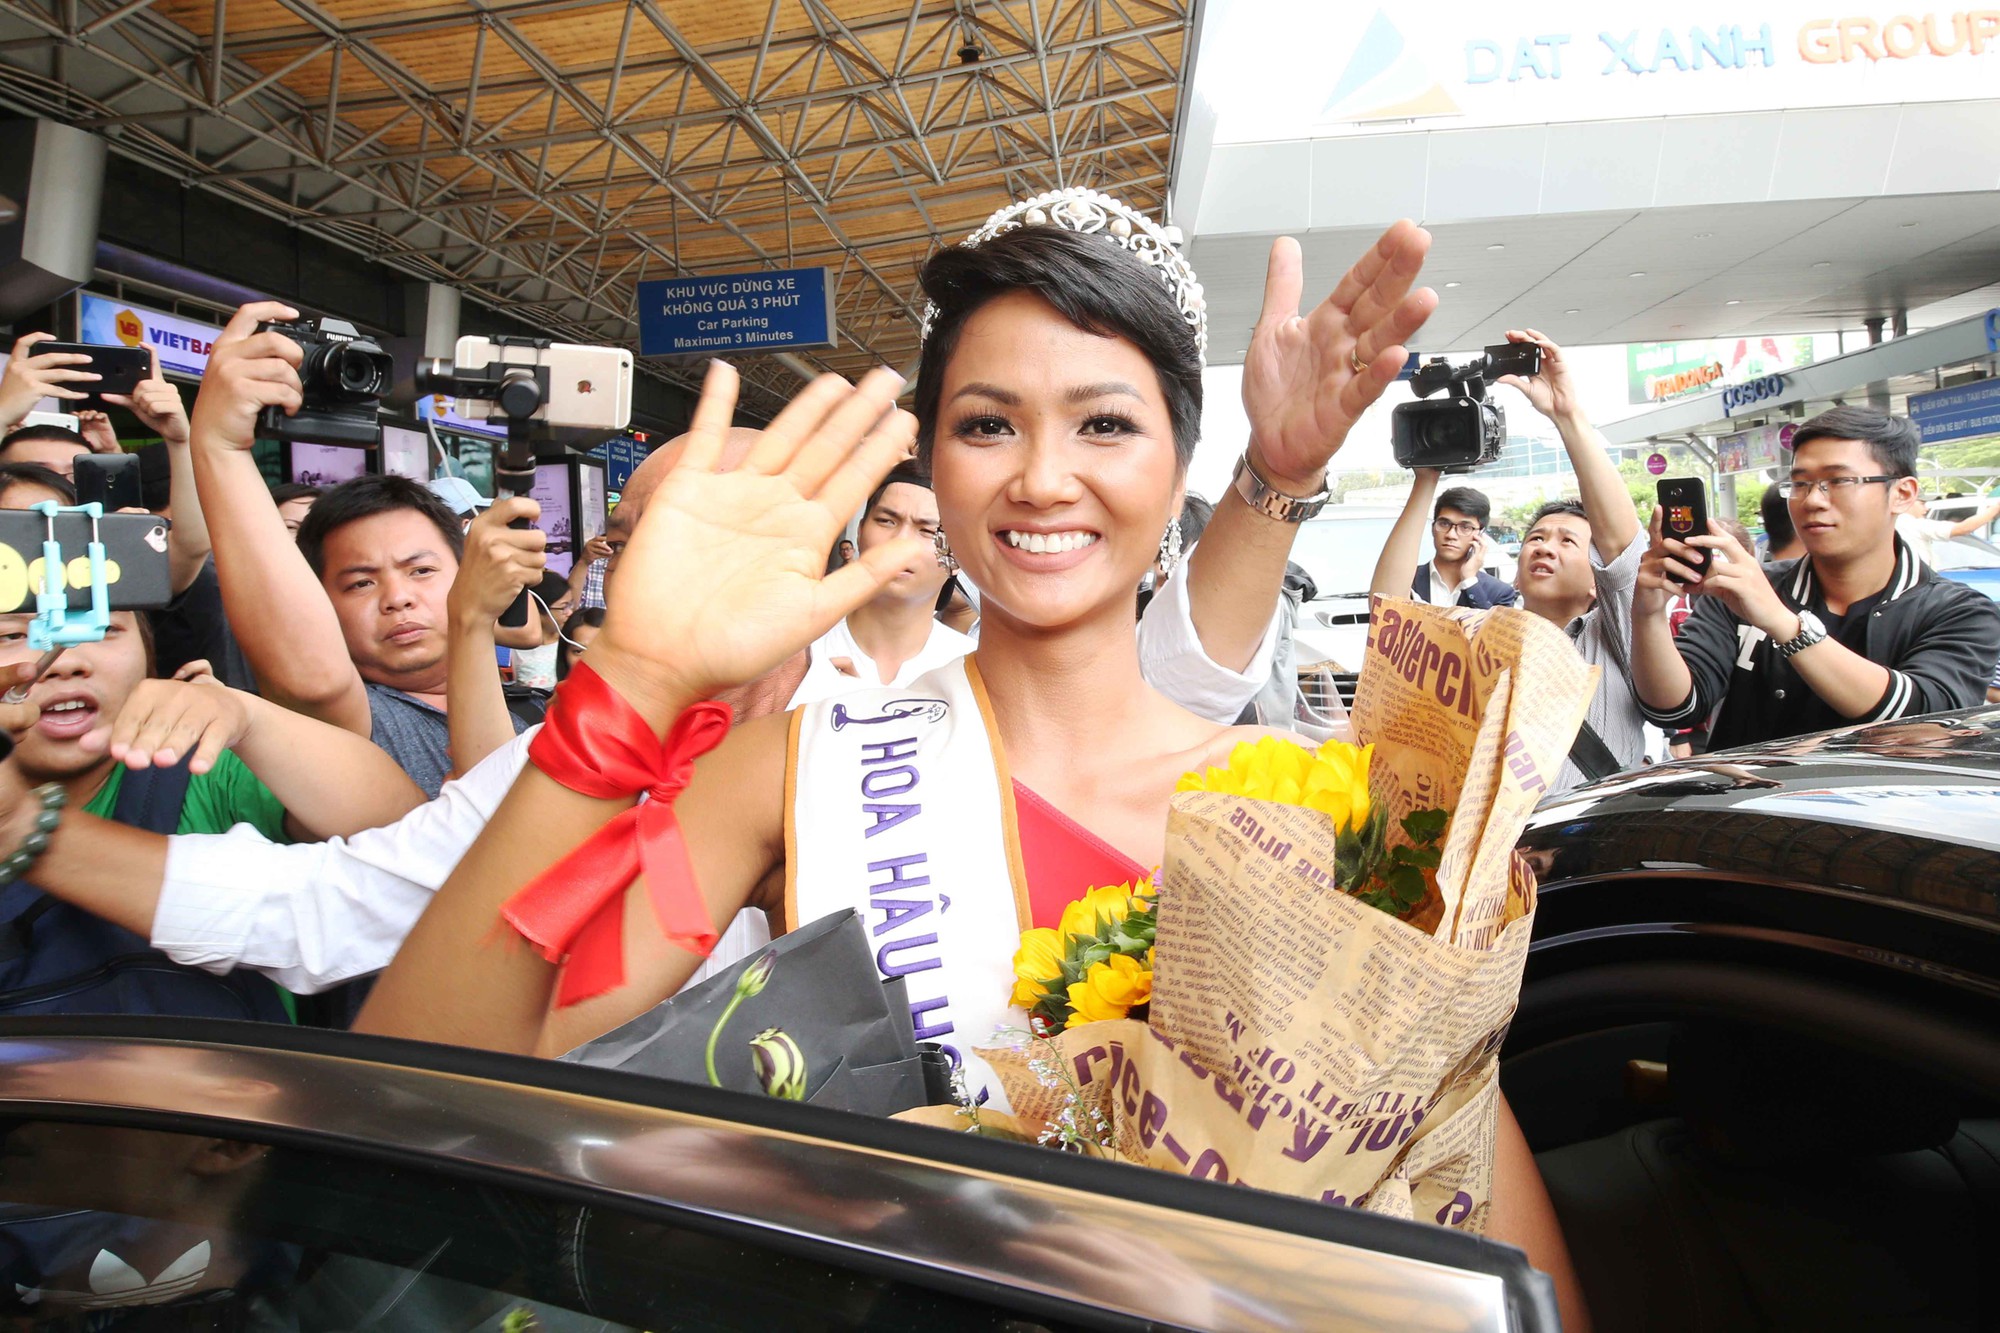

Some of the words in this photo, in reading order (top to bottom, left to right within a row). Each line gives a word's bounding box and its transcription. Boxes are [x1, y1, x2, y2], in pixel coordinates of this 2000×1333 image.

[1464, 34, 1571, 84] DAT
[1598, 23, 1775, 76] XANH
[1797, 10, 2000, 64] GROUP
[666, 287, 695, 299] KHU
[699, 282, 729, 298] VỰC
[732, 278, 773, 294] DỪNG
[777, 278, 795, 291] XE
[663, 300, 713, 316] KHÔNG
[717, 296, 747, 312] QUÁ
[751, 297, 759, 309] 3
[763, 293, 801, 308] PHÚT
[697, 320, 718, 331] Car
[722, 316, 769, 330] Parking
[674, 333, 732, 348] Maximum
[735, 333, 742, 344] 3
[746, 330, 794, 343] Minutes
[861, 736, 922, 839] HOA
[1223, 805, 1294, 865] price
[1278, 822, 1306, 846] smoke
[1204, 856, 1228, 880] naked
[1244, 862, 1266, 882] odds
[1268, 882, 1284, 898] the
[1230, 896, 1254, 920] horse
[1258, 906, 1270, 916] of
[1326, 908, 1338, 920] in
[1254, 916, 1278, 938] word)
[1314, 914, 1330, 928] the
[1338, 916, 1356, 930] one
[1296, 916, 1332, 944] socially
[1242, 936, 1254, 950] by
[1248, 926, 1278, 952] saying
[1278, 936, 1298, 952] bad
[1300, 934, 1316, 948] the
[1334, 942, 1342, 952] is
[1372, 924, 1414, 958] business
[1224, 936, 1254, 964] sincere
[1276, 948, 1298, 964] and
[1372, 940, 1394, 960] way
[1238, 962, 1254, 978] can
[1252, 962, 1272, 978] and
[1298, 962, 1322, 980] gram
[1362, 962, 1376, 978] his
[1394, 956, 1410, 972] his
[1254, 976, 1274, 992] you
[1272, 974, 1308, 1000] earnest
[1376, 974, 1390, 988] up
[1400, 976, 1416, 990] the
[1272, 990, 1294, 1008] Also
[1340, 992, 1356, 1006] the
[1358, 988, 1366, 1000] is
[1372, 986, 1398, 1008] world
[1390, 984, 1418, 1002] picks
[1360, 1006, 1380, 1024] now
[1366, 996, 1392, 1018] which
[1284, 1012, 1294, 1024] to
[1356, 1018, 1368, 1030] no
[1320, 1022, 1346, 1042] came
[1370, 1030, 1380, 1042] is
[1294, 1048, 1308, 1060] go
[1304, 1040, 1324, 1056] and
[1310, 1060, 1320, 1070] to
[1334, 1048, 1356, 1068] Dick
[1322, 1052, 1358, 1084] Sunday
